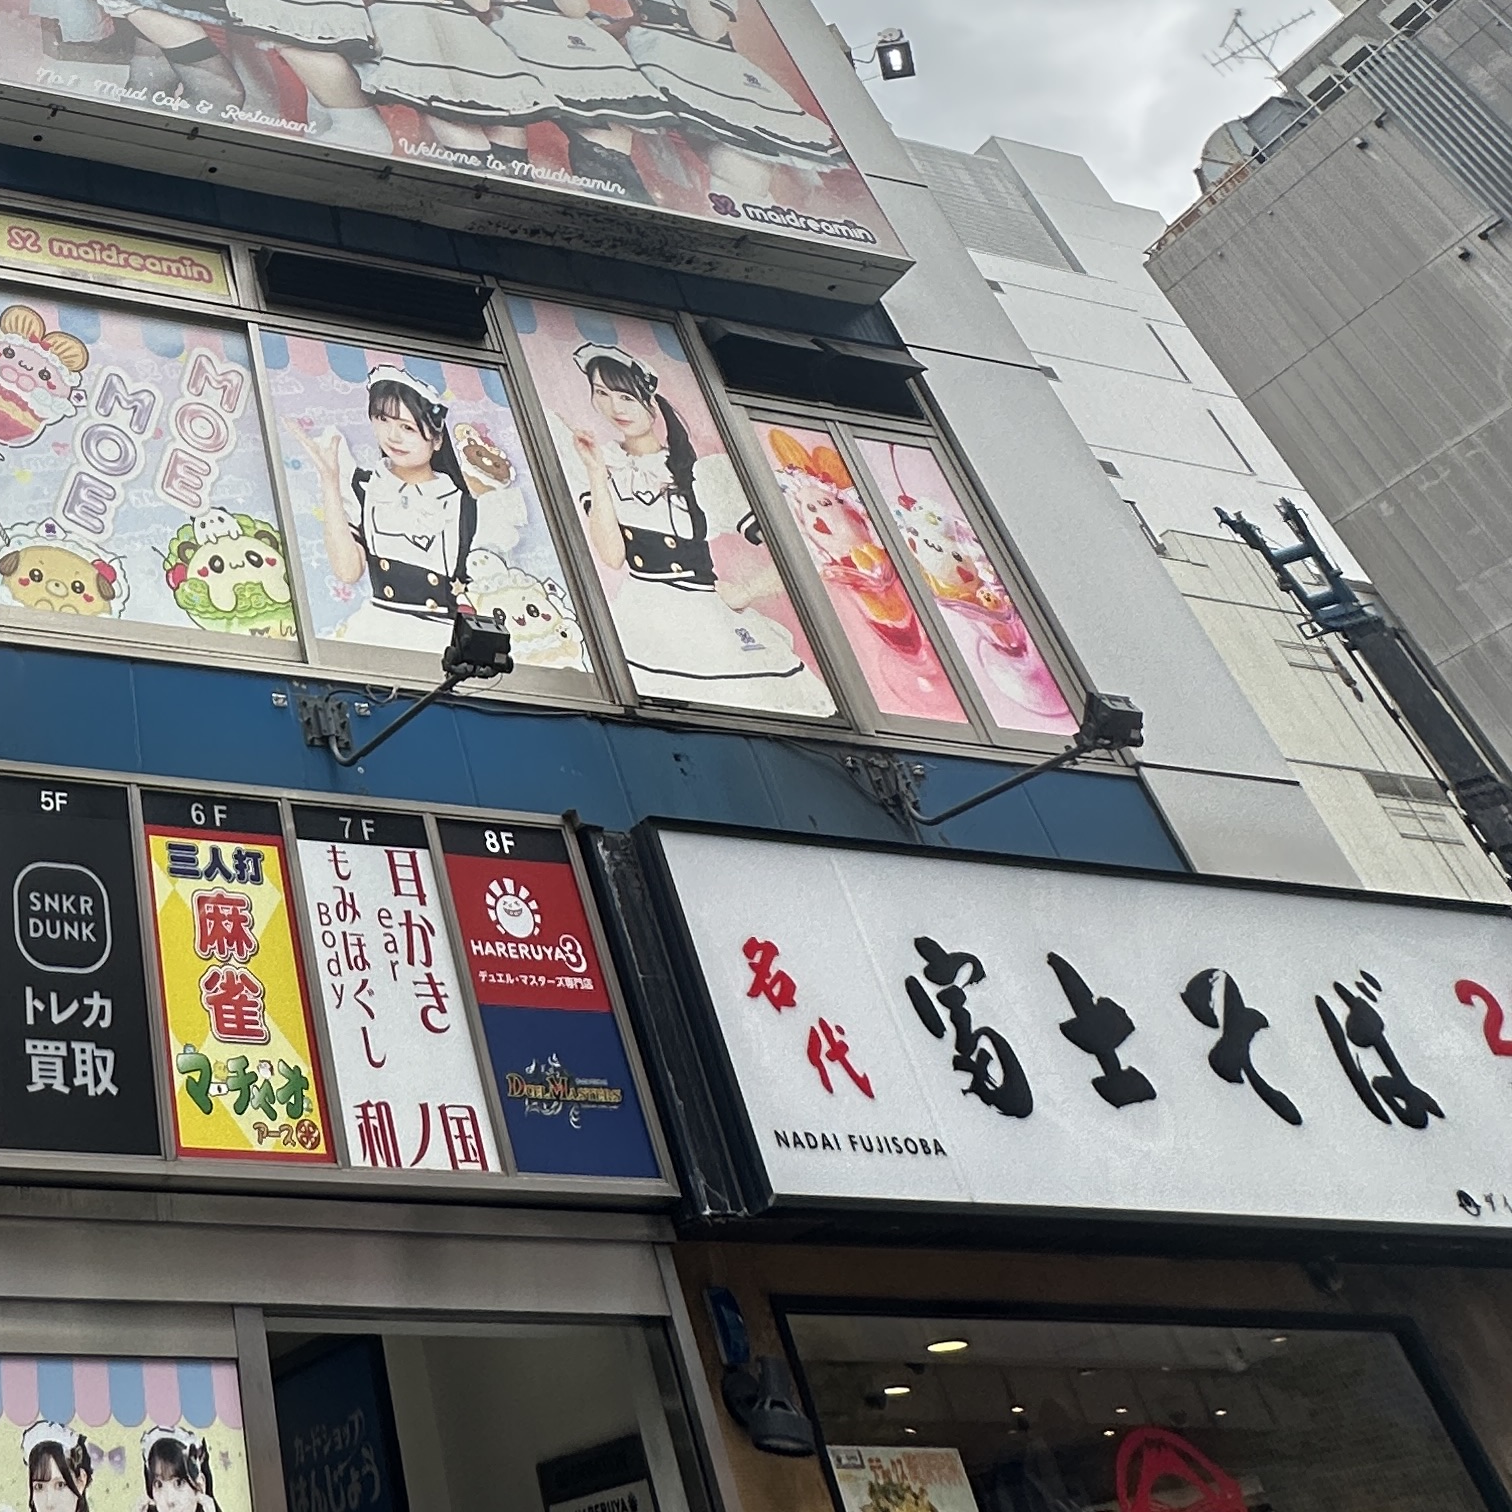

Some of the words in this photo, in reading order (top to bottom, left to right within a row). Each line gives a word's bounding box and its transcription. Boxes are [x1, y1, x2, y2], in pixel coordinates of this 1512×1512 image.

[221, 104, 317, 134] Restaurant
[398, 137, 482, 167] Welcome
[486, 154, 506, 171] to
[511, 159, 626, 195] Maidreamin
[743, 204, 876, 243] maidreamin
[49, 234, 214, 285] maidreamin
[61, 372, 157, 536] MOE
[160, 353, 245, 509] MOE
[40, 790, 68, 812] 5F
[165, 841, 265, 885] 三人打
[484, 829, 517, 855] 8F
[28, 917, 97, 943] DUNK
[29, 891, 94, 917] SNKR
[192, 886, 270, 1045] 麻雀
[316, 901, 345, 1009] Body
[326, 844, 387, 1069] もみほぐし
[377, 906, 400, 982] ear
[383, 848, 451, 1035] 耳かき
[24, 985, 113, 1028] トレカ
[742, 935, 875, 1100] 名代
[904, 935, 1446, 1130] 富士そば
[24, 1038, 119, 1097] 買取
[352, 1099, 490, 1171] 和ノ国
[773, 1128, 842, 1153] NADAI
[847, 1133, 948, 1158] FUJISOBA
